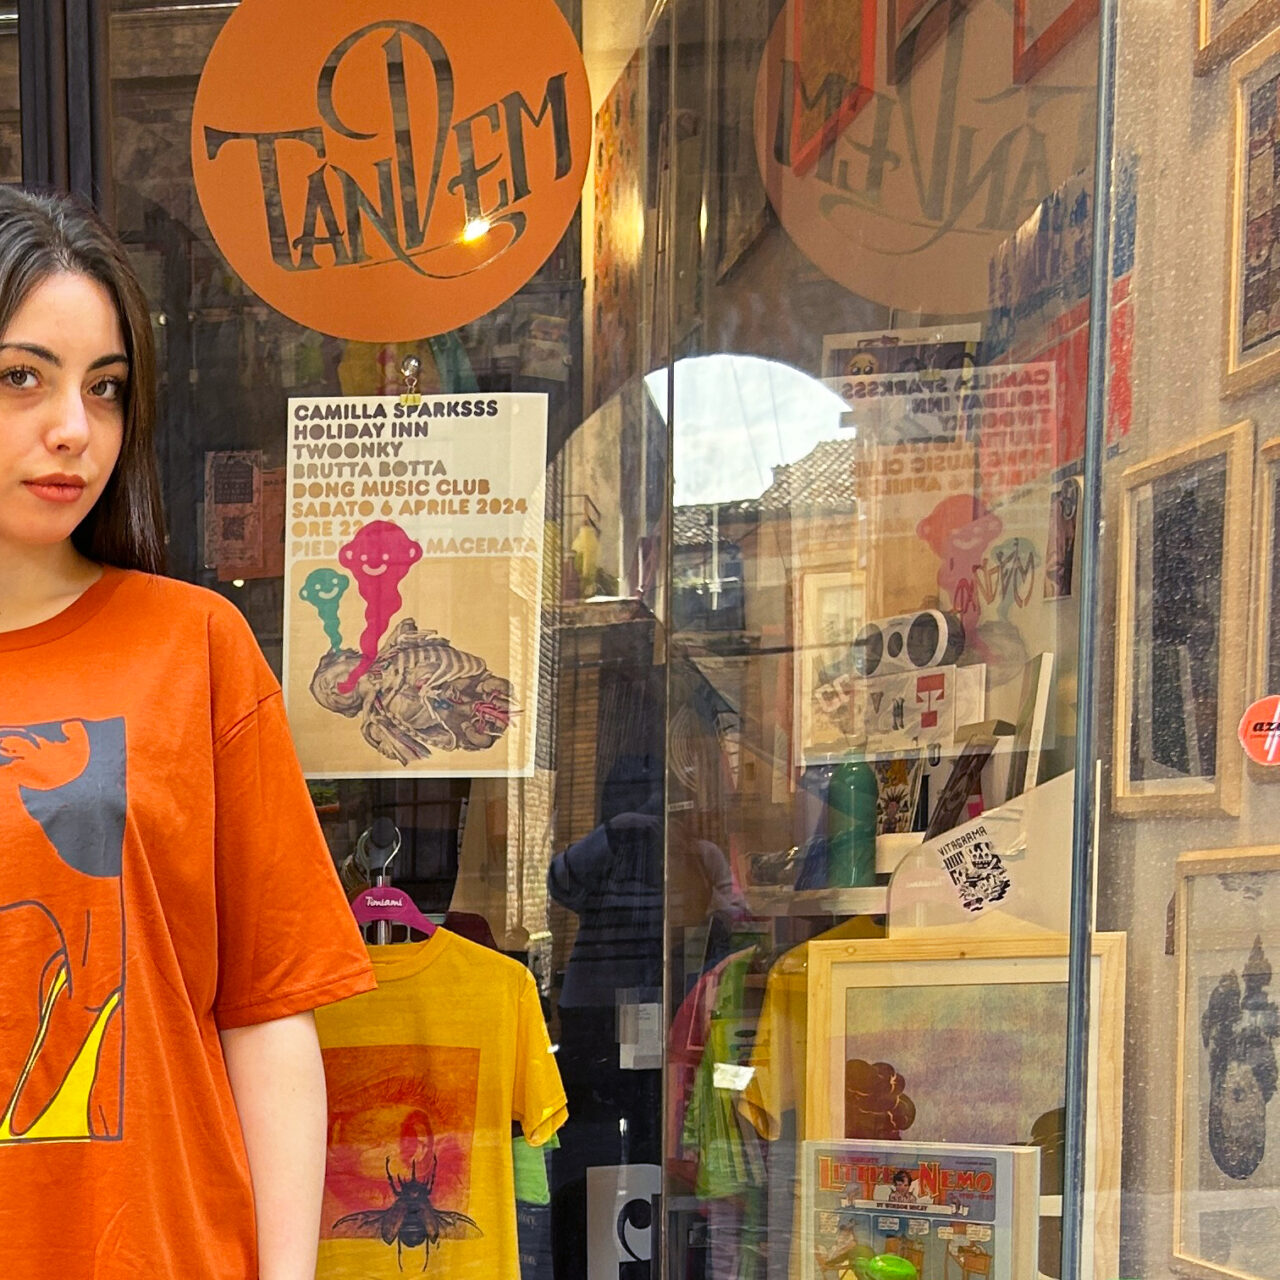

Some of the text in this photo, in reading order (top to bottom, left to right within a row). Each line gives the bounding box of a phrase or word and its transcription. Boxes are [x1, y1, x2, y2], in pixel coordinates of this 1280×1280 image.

[204, 20, 573, 279] TANDEM
[293, 400, 498, 421] CAMILLA SPARKSSS
[294, 421, 429, 440] HOLIDAY INN
[293, 442, 403, 460] TWOONKY
[293, 460, 447, 479] BRUTTA BOTTA
[292, 479, 491, 499] DONG MUSIC CLUB
[292, 498, 528, 518] SABATO 6 APRILE 2024
[291, 521, 333, 538] ORE
[292, 537, 538, 557] PIED MACERATA
[937, 826, 987, 857] VITAGRAMA
[818, 1156, 993, 1200] LITTLE NEMO
